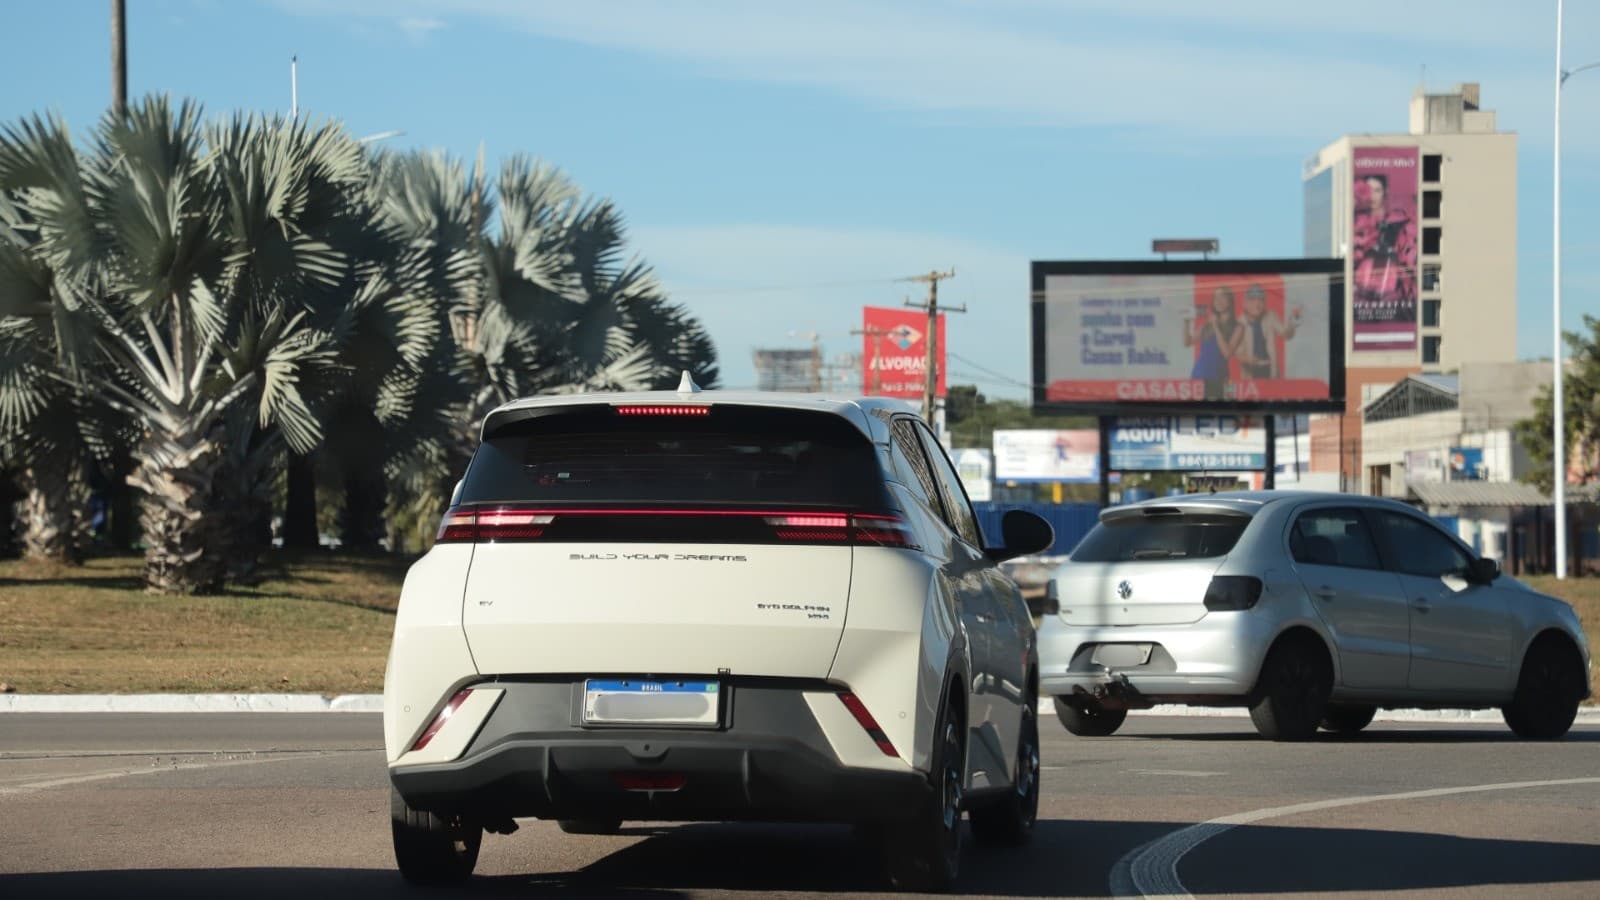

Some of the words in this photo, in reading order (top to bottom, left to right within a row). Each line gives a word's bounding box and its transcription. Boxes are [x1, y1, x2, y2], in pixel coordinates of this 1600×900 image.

[1126, 313, 1155, 328] com
[1081, 349, 1122, 365] Casas
[869, 356, 939, 375] ALVORA
[569, 553, 618, 561] BUILD
[623, 553, 669, 561] YOUR
[673, 553, 748, 562] DREAMS
[641, 684, 663, 692] BRASIL
